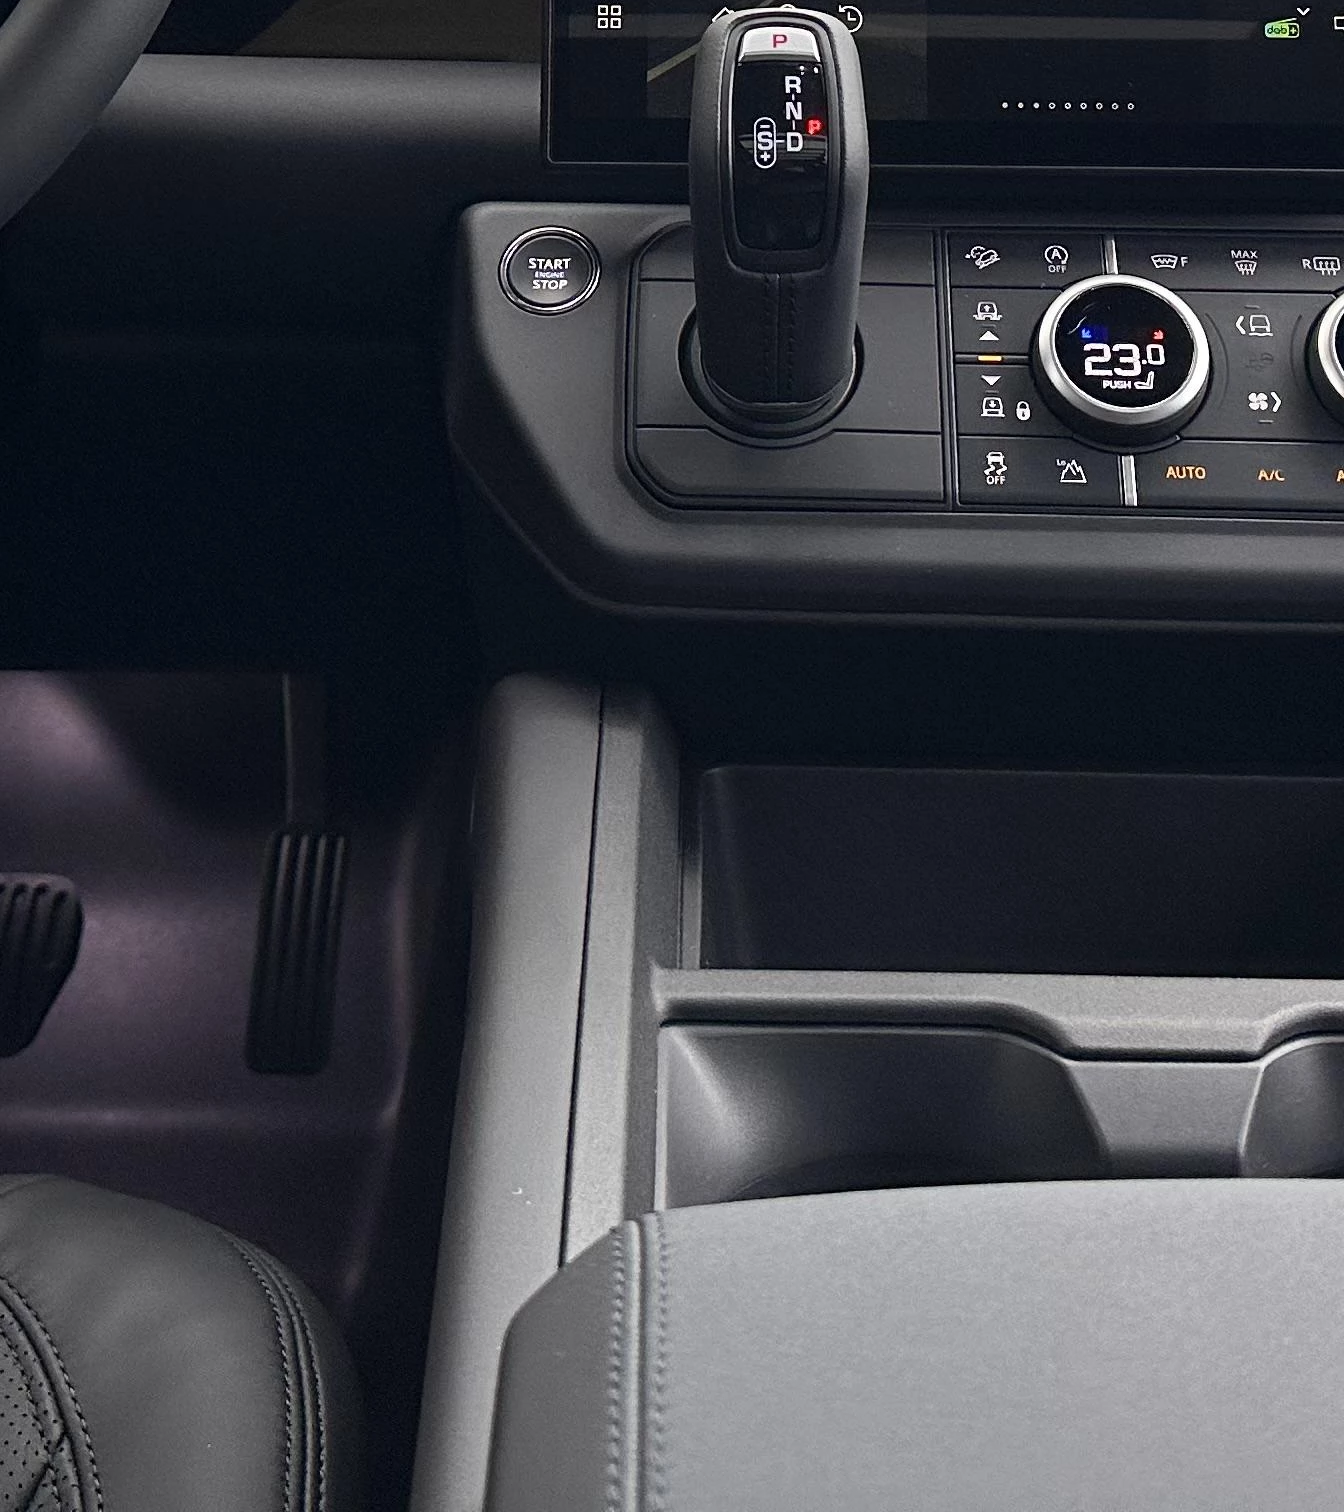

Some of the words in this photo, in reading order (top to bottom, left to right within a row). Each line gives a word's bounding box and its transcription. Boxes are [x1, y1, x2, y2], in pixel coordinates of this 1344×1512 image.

[772, 34, 788, 48] P
[784, 75, 802, 94] R
[785, 101, 803, 120] N
[807, 118, 823, 135] P
[786, 131, 804, 152] D
[1230, 249, 1258, 259] MAX
[527, 257, 572, 270] START
[1047, 264, 1067, 273] OFF
[1301, 258, 1312, 270] R
[532, 279, 568, 290] STOP
[1083, 343, 1166, 377] 23.0
[1102, 380, 1132, 389] PUSH
[1166, 465, 1206, 480] AUTO
[1257, 468, 1286, 481] A/C
[986, 475, 1006, 486] OFF
